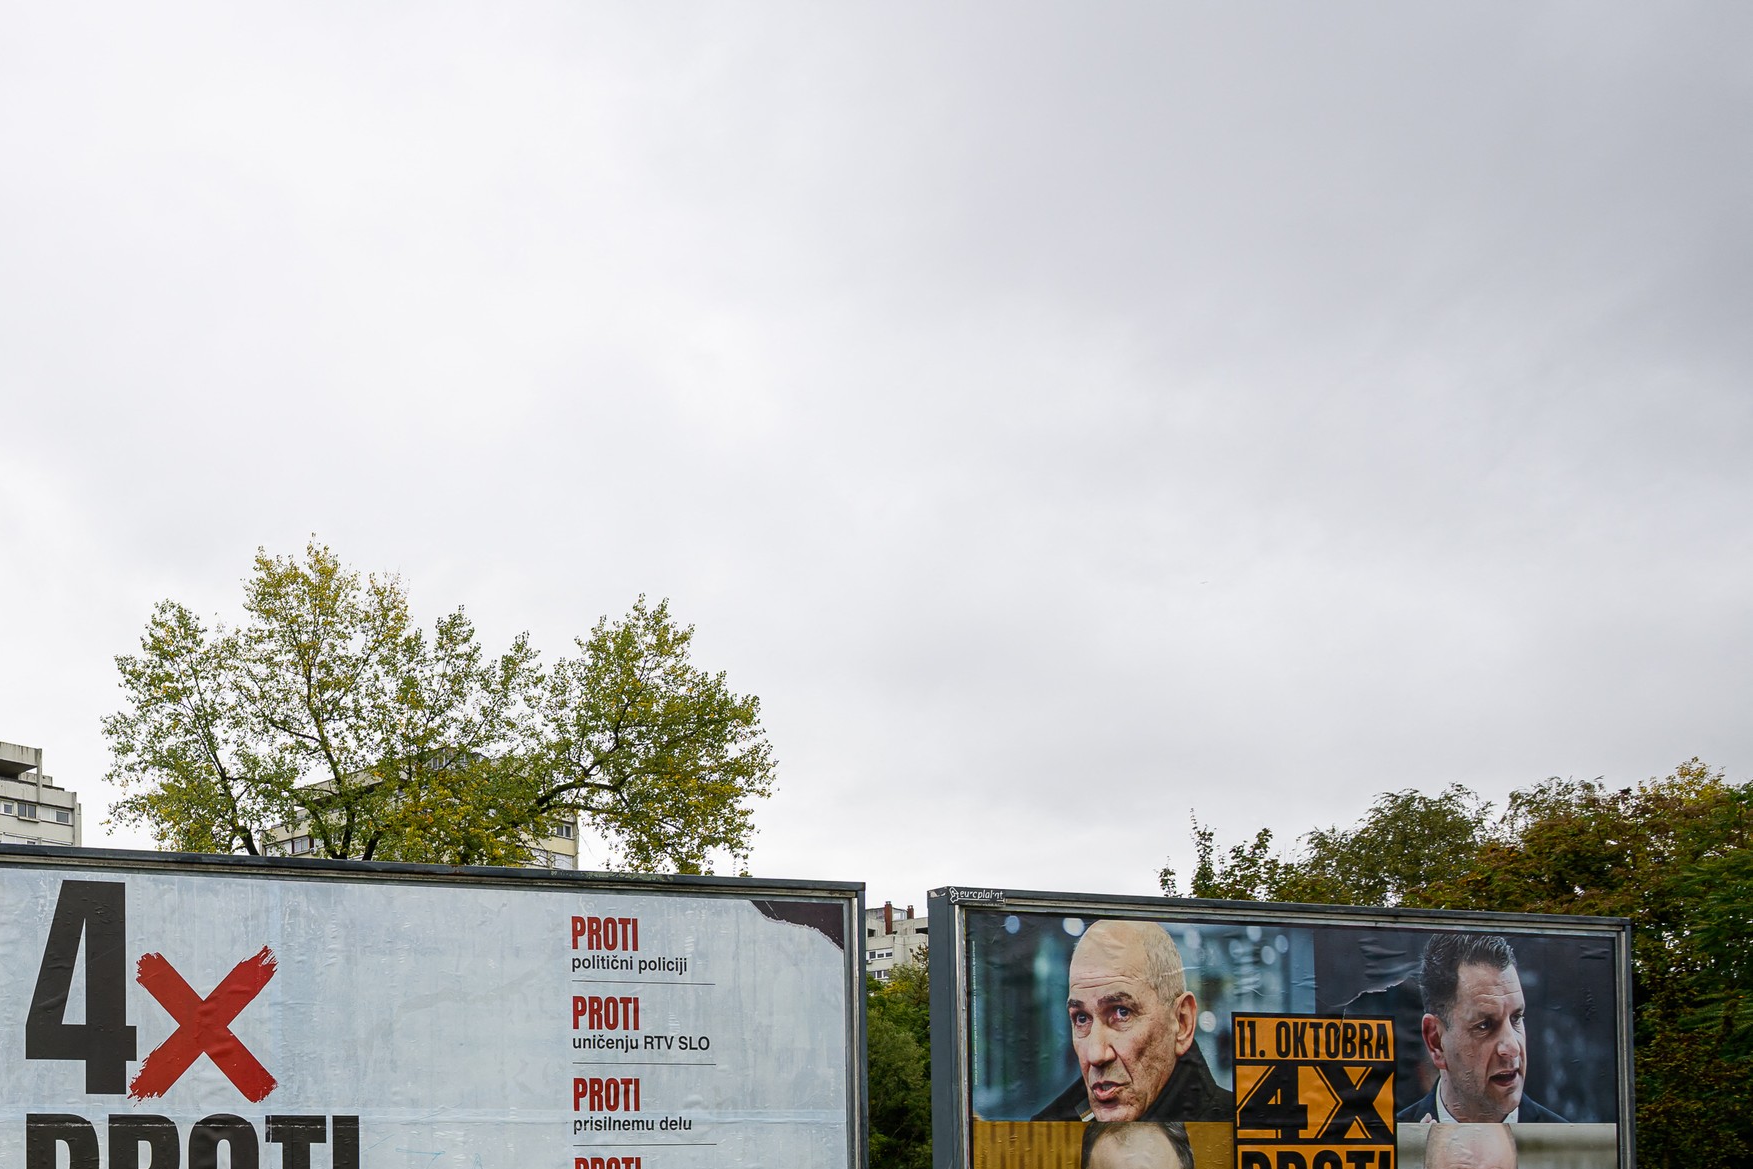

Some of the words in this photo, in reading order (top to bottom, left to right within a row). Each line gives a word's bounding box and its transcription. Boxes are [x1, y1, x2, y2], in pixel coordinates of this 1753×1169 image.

[572, 915, 639, 952] PROTI
[572, 954, 634, 973] politični
[638, 956, 688, 976] policiji
[572, 995, 640, 1031] PROTI
[572, 1036, 639, 1054] uničenju
[643, 1036, 675, 1050] RTV
[678, 1036, 710, 1051] SLO
[1236, 1020, 1267, 1058] 11.
[1275, 1020, 1391, 1060] OKTOBRA
[574, 1077, 641, 1112] PROTI
[1237, 1065, 1394, 1139] 4X
[573, 1116, 655, 1135] prisilnemu
[659, 1116, 692, 1131] delu
